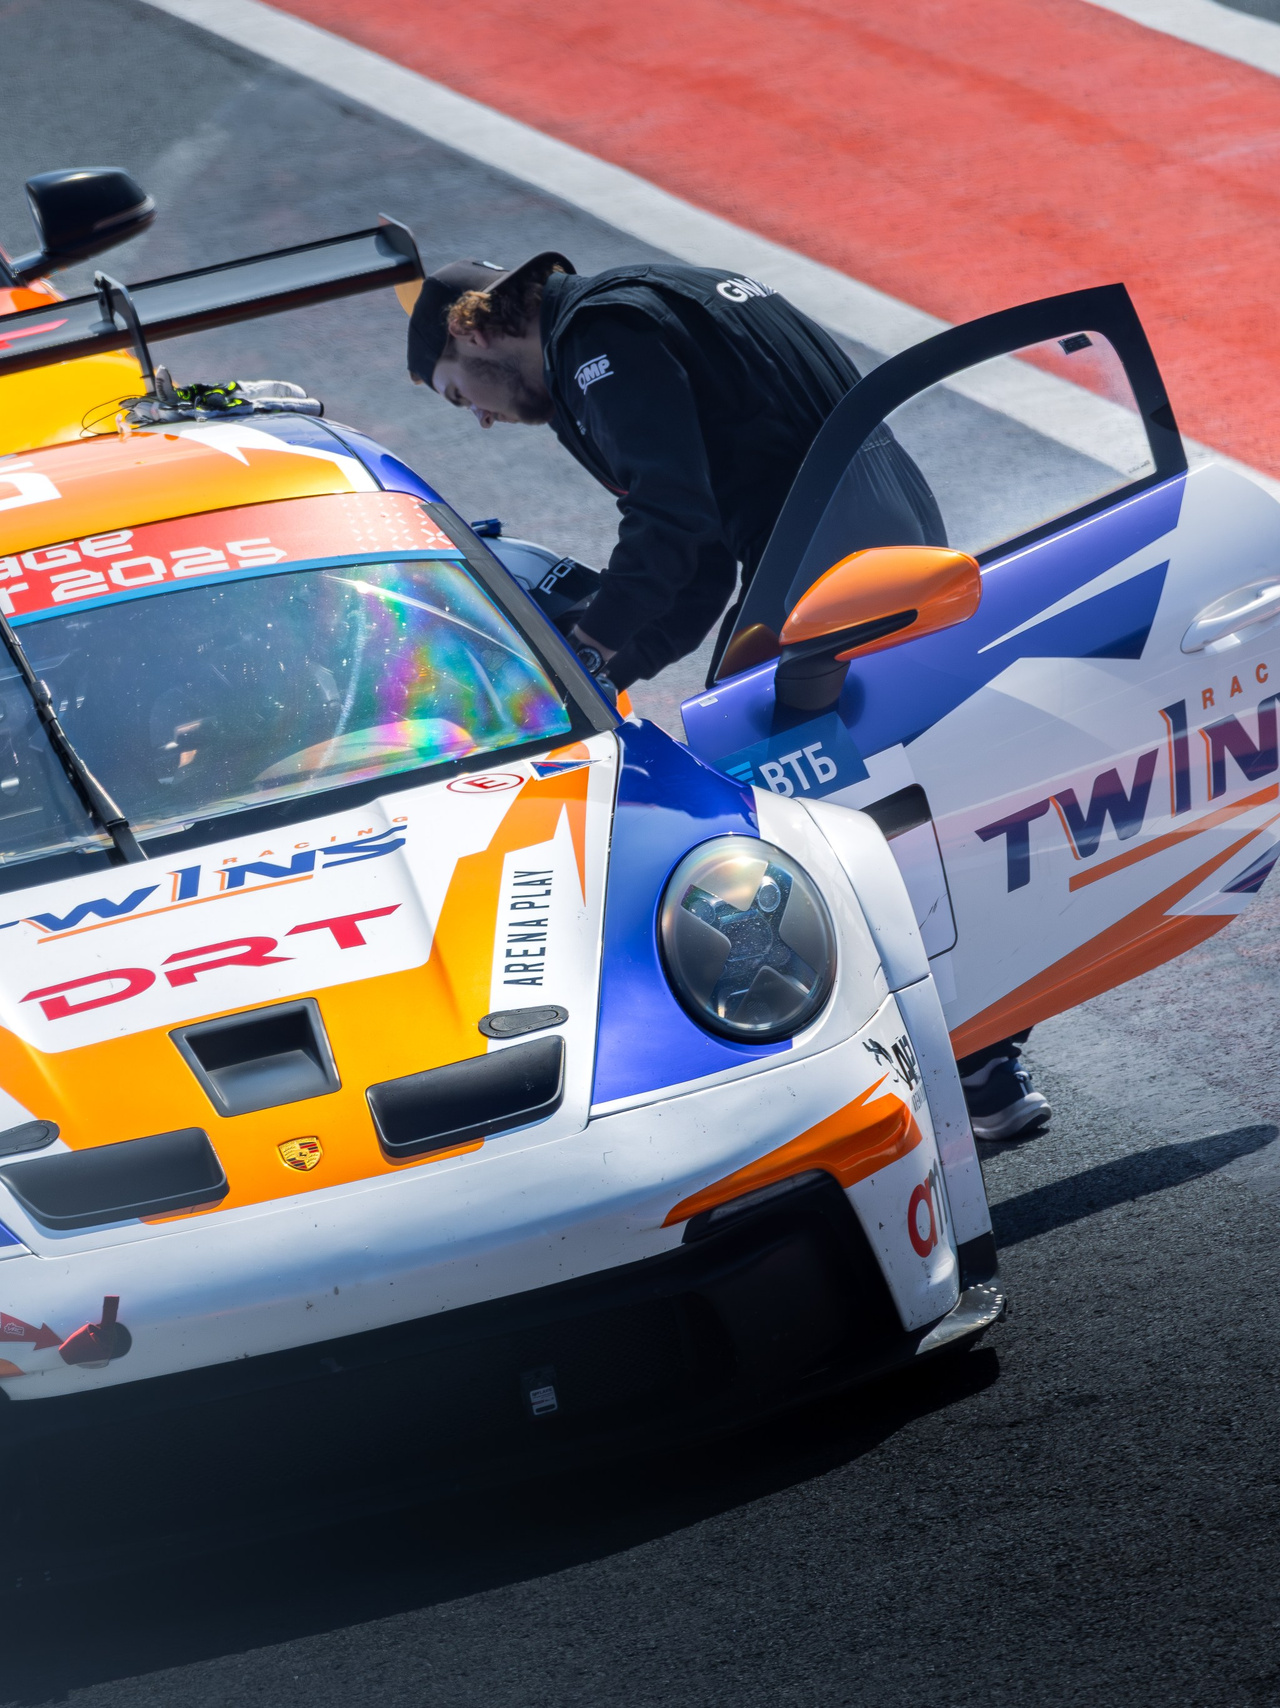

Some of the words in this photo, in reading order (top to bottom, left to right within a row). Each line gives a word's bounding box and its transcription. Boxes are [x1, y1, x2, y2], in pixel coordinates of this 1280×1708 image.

[577, 357, 611, 392] OMP
[50, 537, 287, 604] 2025
[1201, 663, 1269, 710] RAC
[759, 741, 838, 798] ВТБ
[222, 815, 408, 866] RACING
[510, 869, 554, 911] PLAY
[18, 903, 403, 1022] DRT
[503, 917, 549, 986] ARENA
